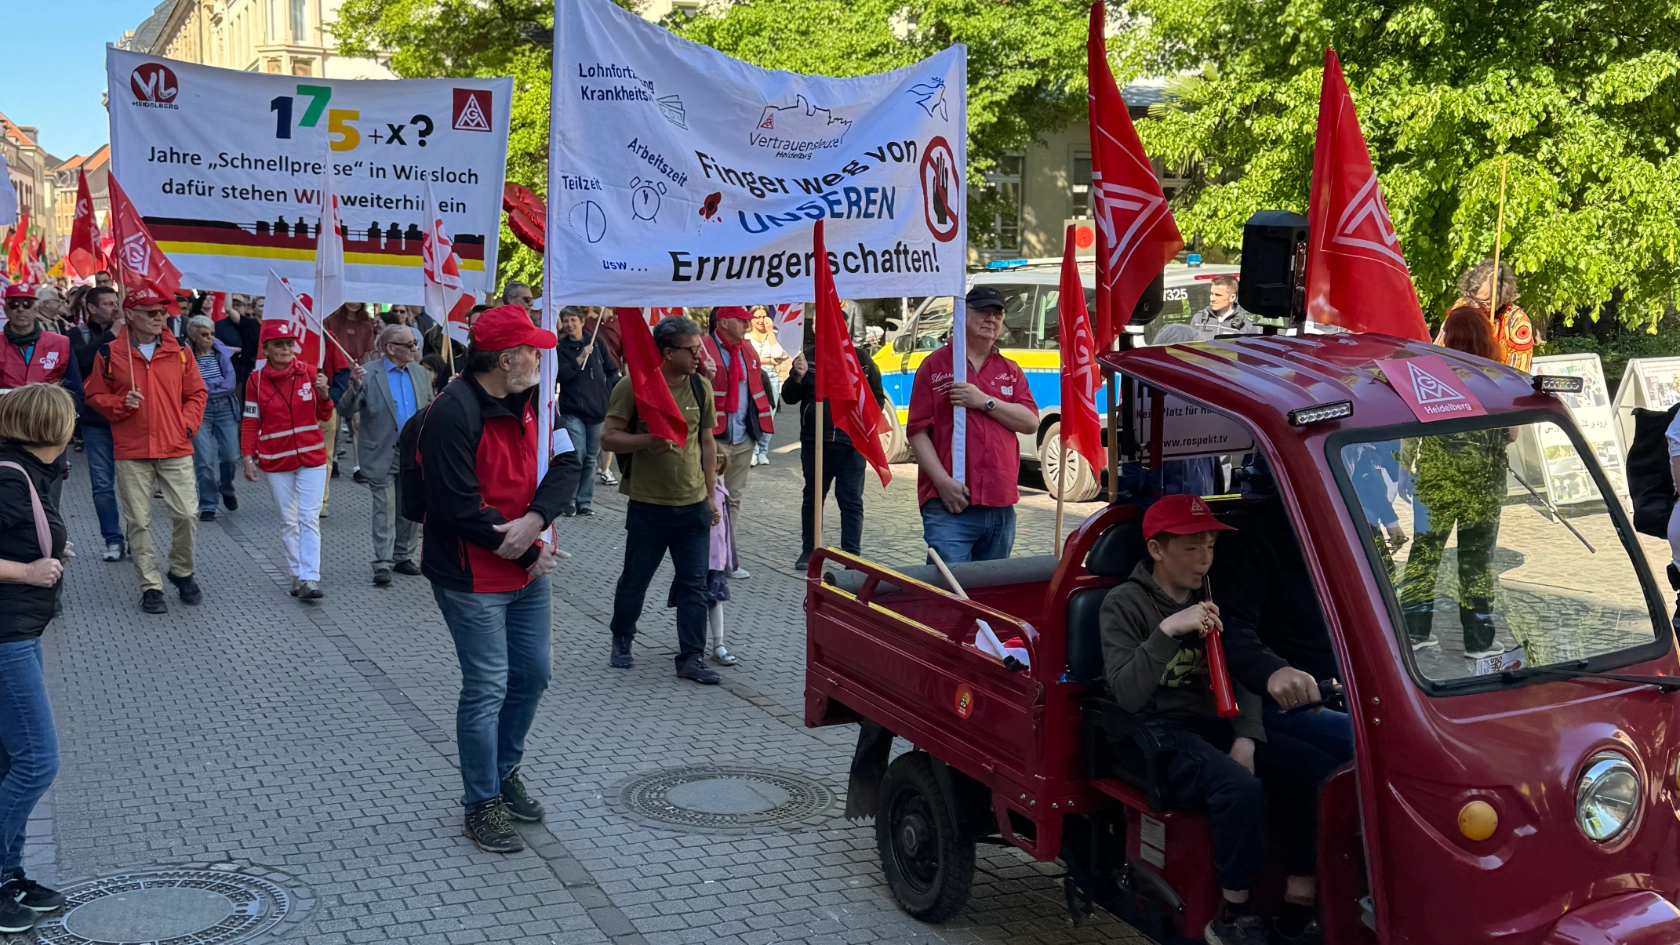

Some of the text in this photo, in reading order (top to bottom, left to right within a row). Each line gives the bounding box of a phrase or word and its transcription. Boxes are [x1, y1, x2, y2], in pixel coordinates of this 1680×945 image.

[148, 146, 202, 166] Jahre
[369, 162, 386, 179] in
[392, 164, 479, 185] Wiesloch
[627, 137, 688, 187] Arbeitszeit
[695, 140, 917, 199] Finger weg von
[161, 178, 215, 197] dafür
[221, 183, 288, 203] stehen
[294, 188, 322, 206] WI
[438, 197, 467, 214] ein
[738, 186, 896, 234] UNSEREN
[1185, 405, 1199, 416] für
[1423, 403, 1472, 414] Heidelberg
